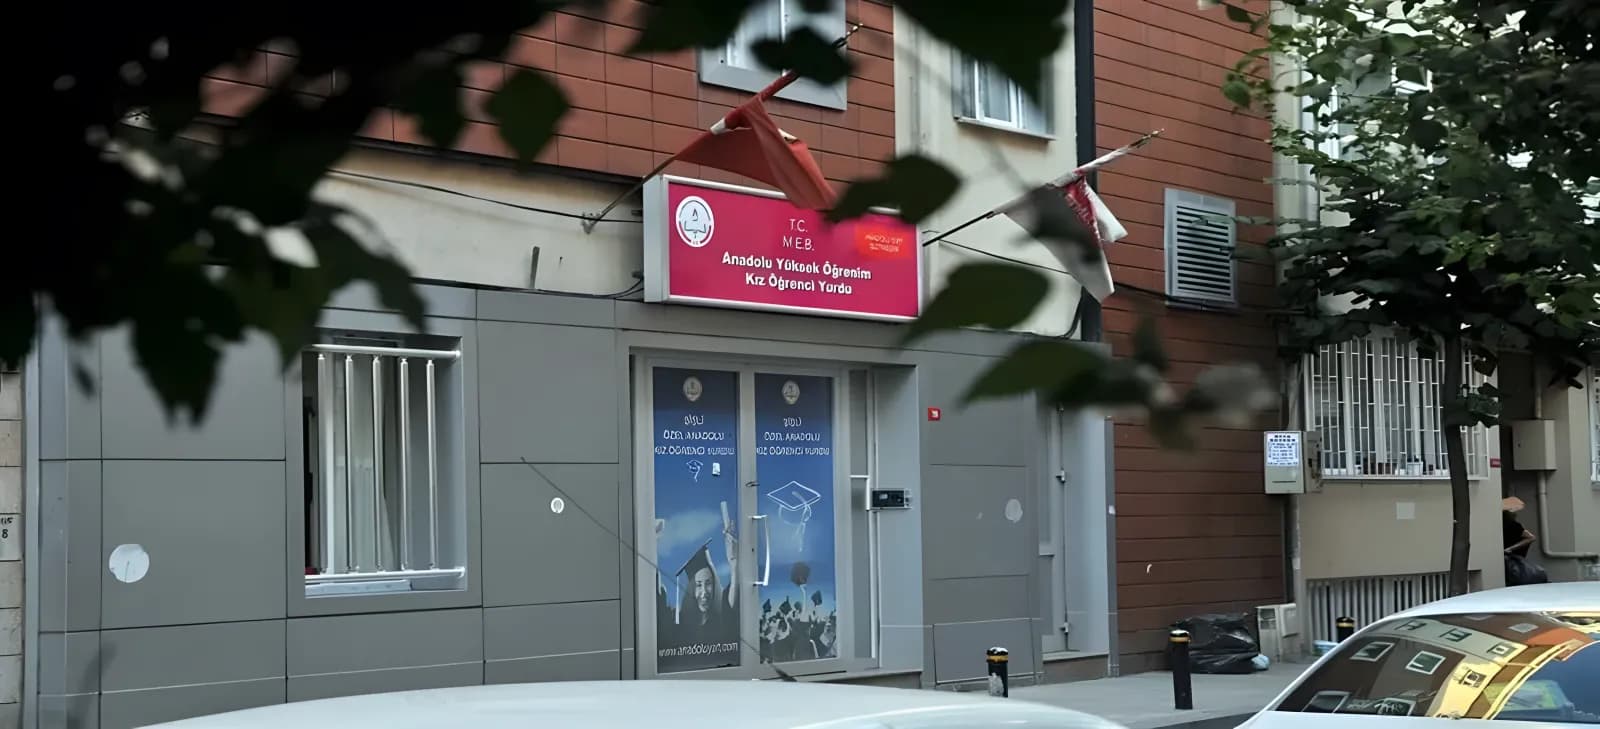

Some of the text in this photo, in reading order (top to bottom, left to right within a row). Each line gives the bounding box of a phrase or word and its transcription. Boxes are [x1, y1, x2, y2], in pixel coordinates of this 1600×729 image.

[721, 251, 773, 269] Anadolu
[822, 260, 872, 280] Öğrenim
[768, 273, 815, 291] Öğrenci
[819, 279, 853, 295] Yurdu
